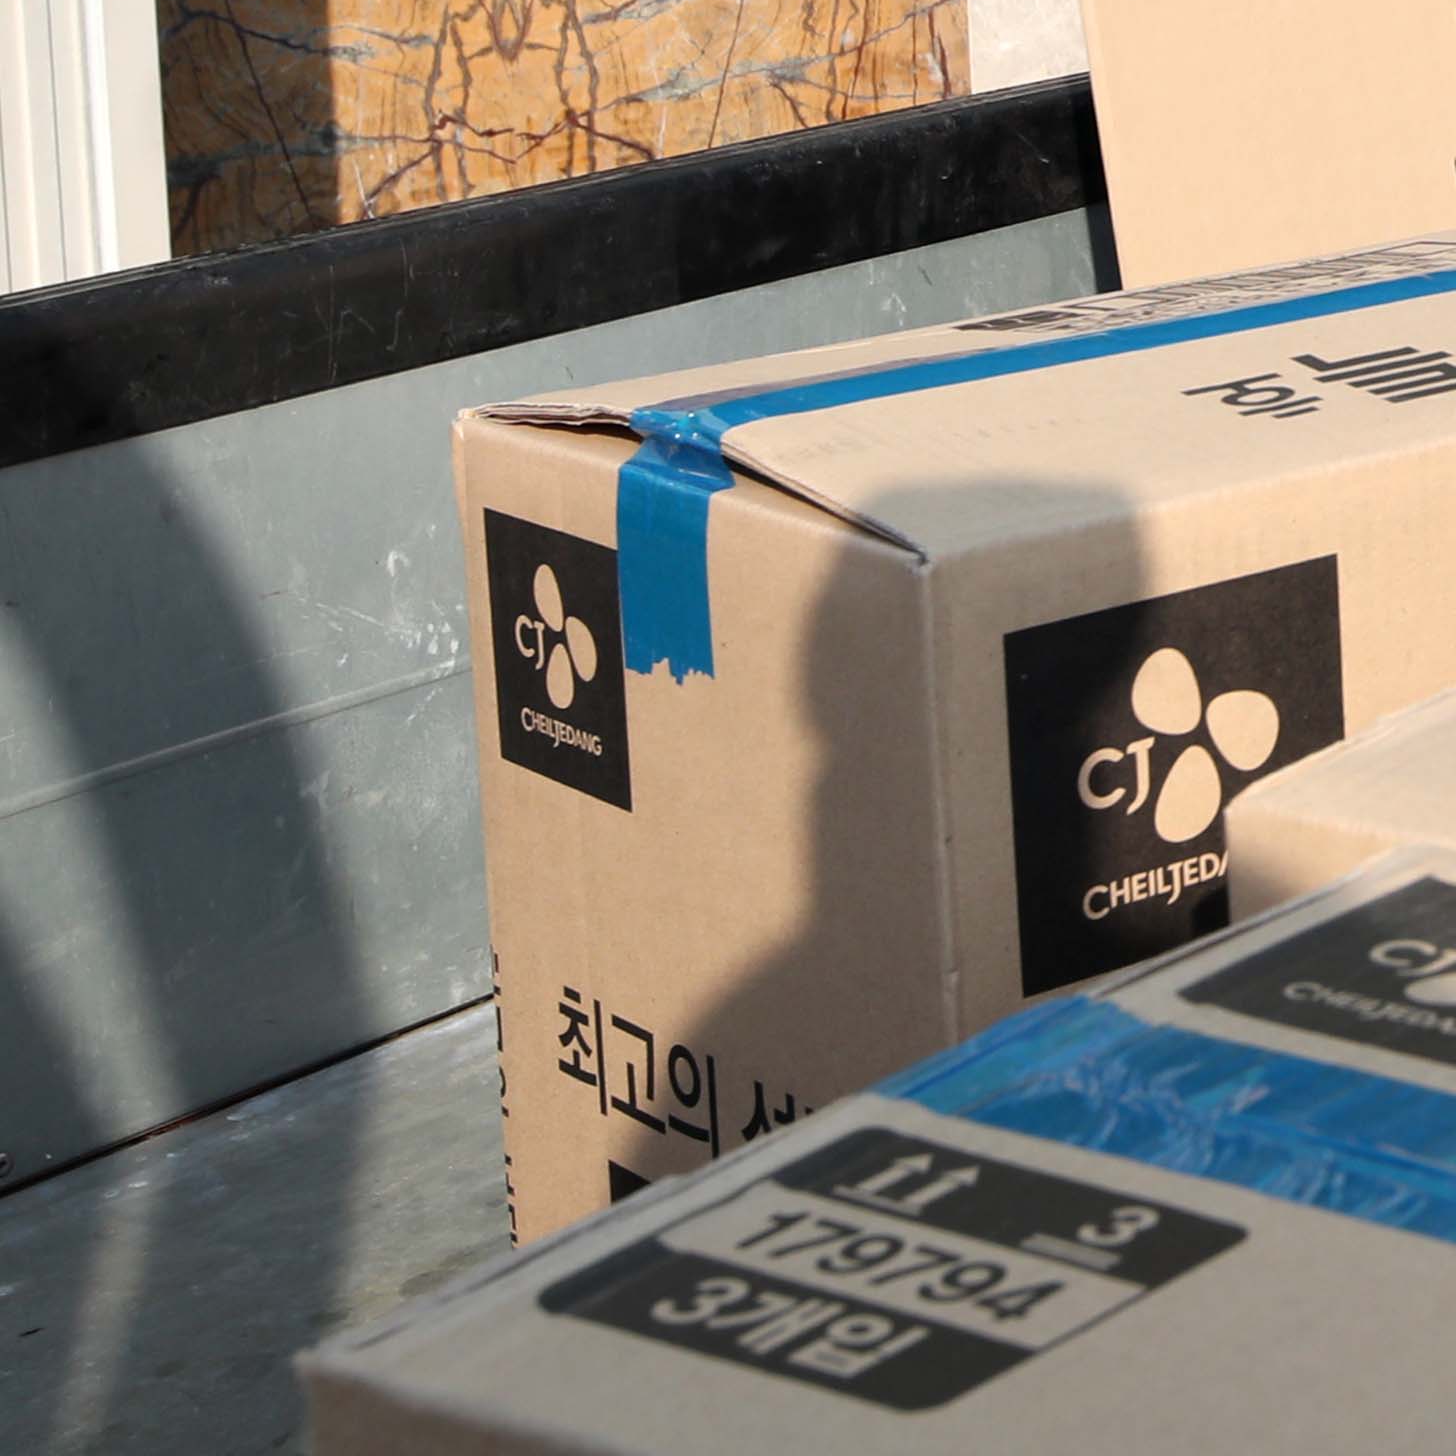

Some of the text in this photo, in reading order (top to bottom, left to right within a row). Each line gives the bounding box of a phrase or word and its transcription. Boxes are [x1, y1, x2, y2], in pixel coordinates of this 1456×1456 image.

[514, 614, 545, 670] CJ
[521, 706, 603, 757] CHEILJEDANG
[1077, 736, 1155, 816] CJ
[1082, 849, 1229, 921] CHEILJED
[557, 985, 721, 1158] 최고의
[1077, 1206, 1160, 1249] 3
[734, 1208, 1071, 1325] 179794
[651, 1277, 931, 1380] 3개입
